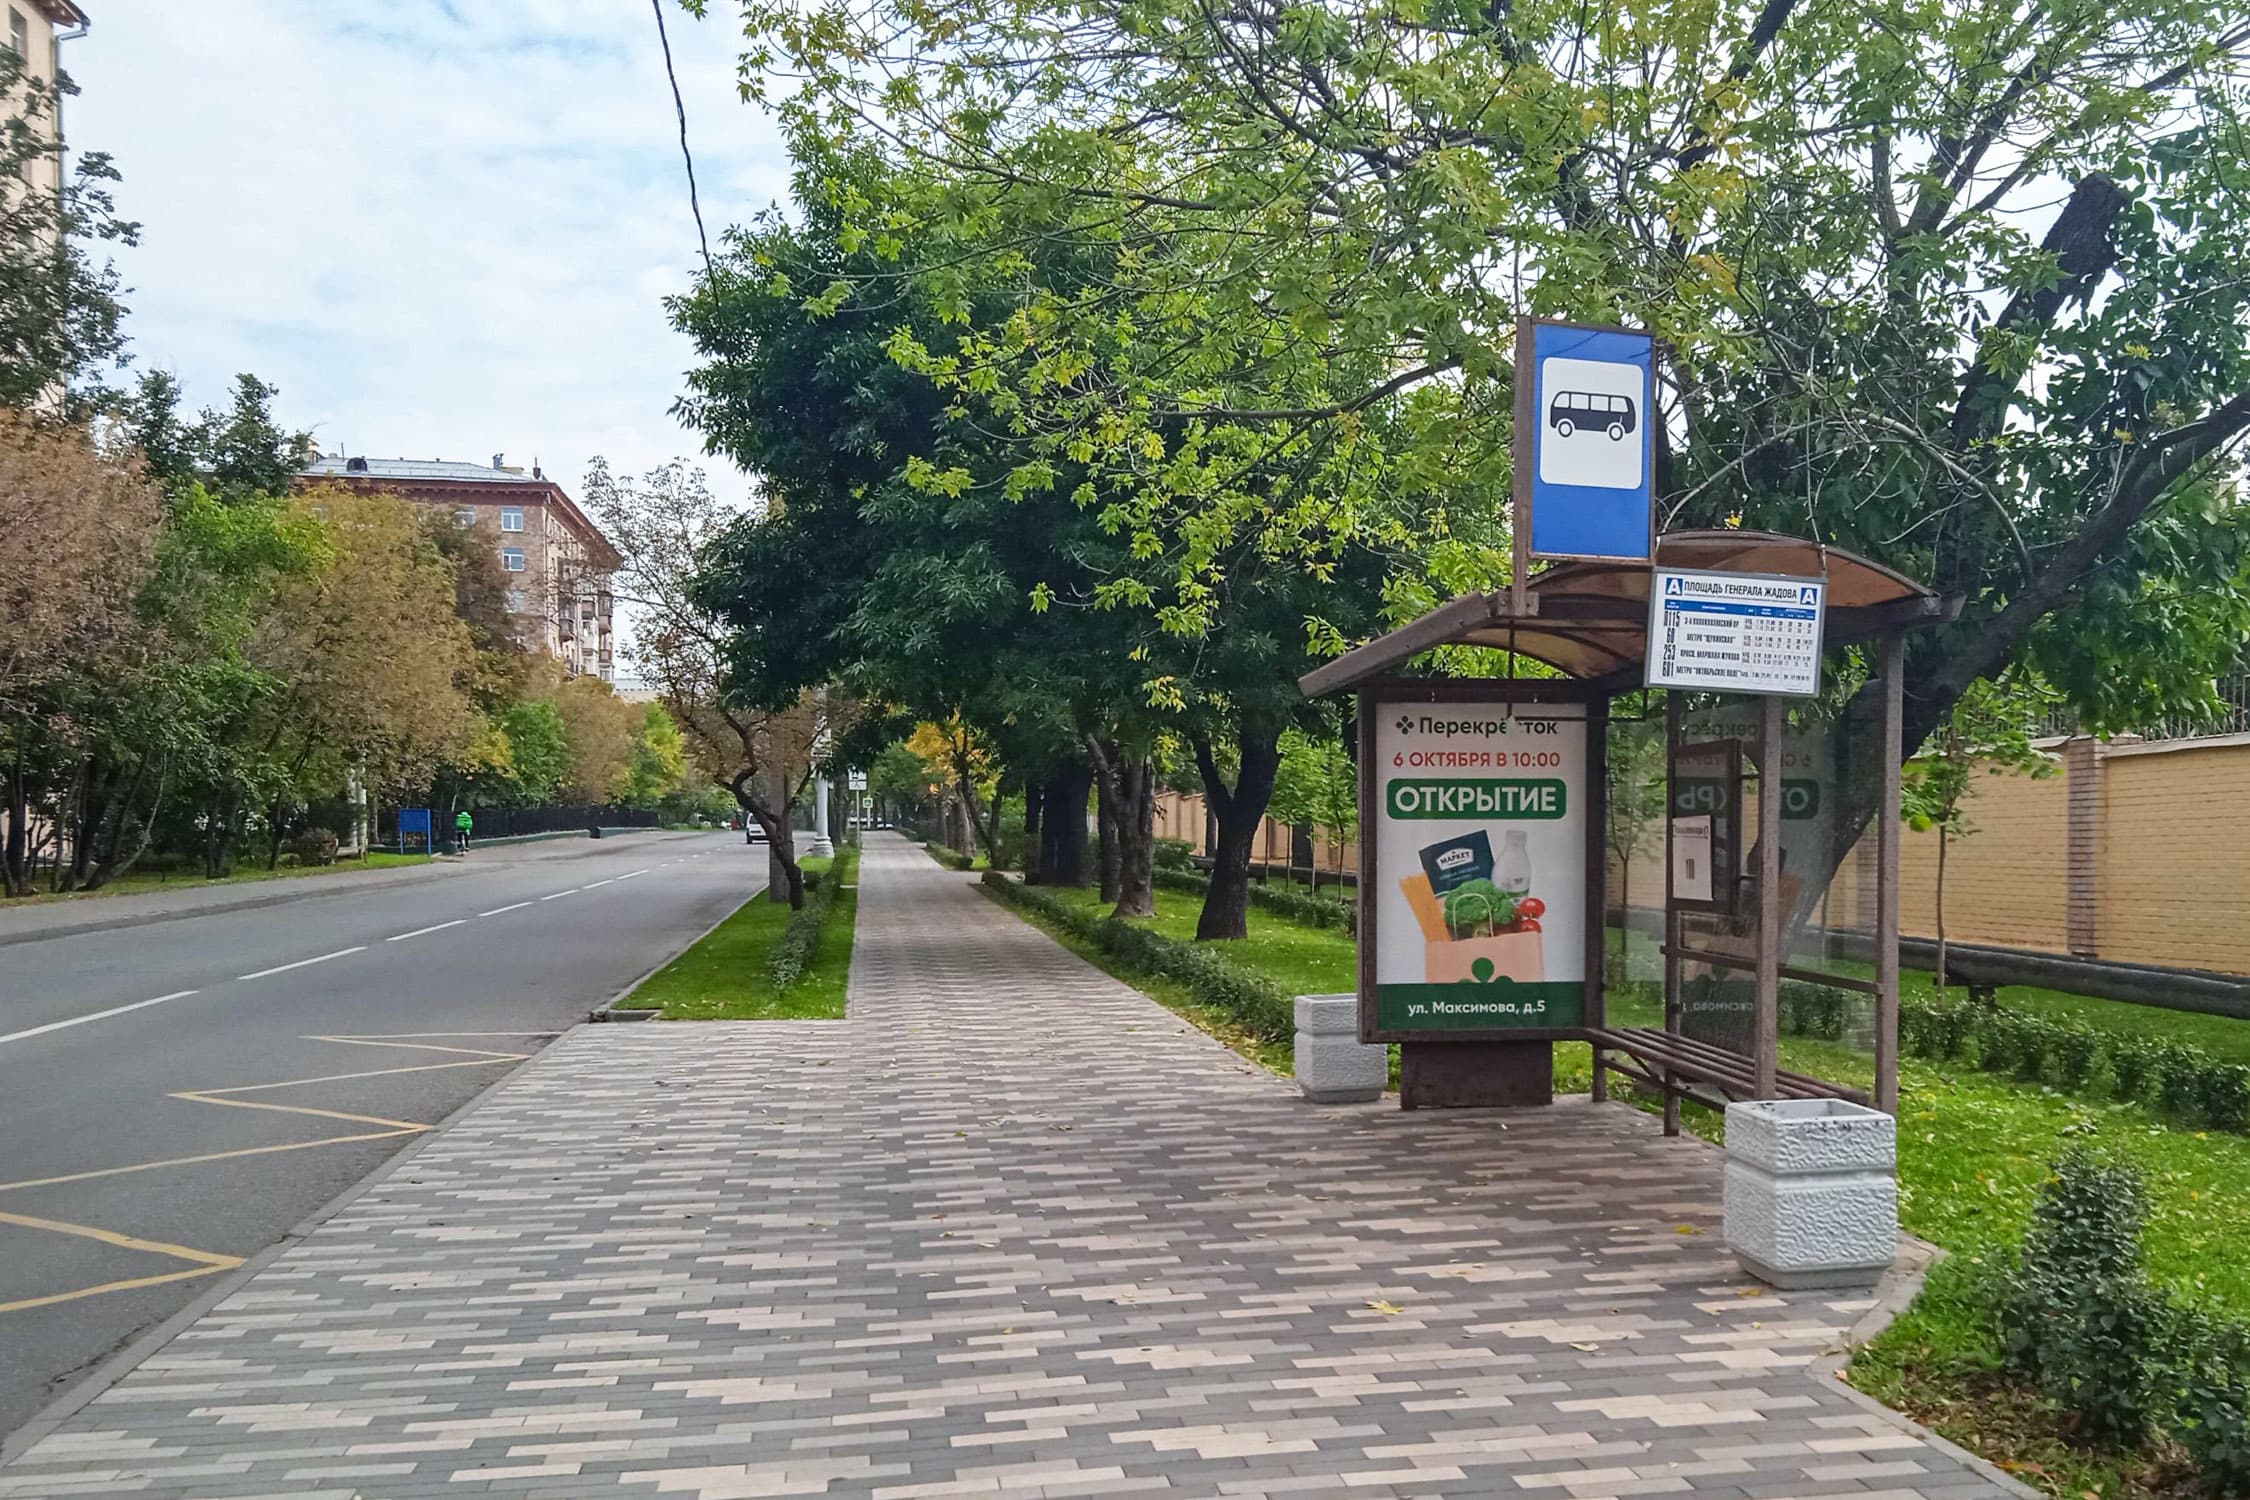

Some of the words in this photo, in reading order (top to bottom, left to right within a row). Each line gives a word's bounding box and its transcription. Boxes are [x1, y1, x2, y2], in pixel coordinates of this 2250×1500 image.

[1684, 581, 1723, 595] ПЛОЩАДЬ
[1724, 584, 1763, 597] ГЕНЕРАЛА
[1764, 586, 1797, 600] ЖАДОВА
[1663, 644, 1676, 660] 253
[1393, 752, 1404, 767] 6
[1409, 752, 1491, 767] ОКТЯБРЯ
[1496, 752, 1507, 767] В
[1512, 752, 1561, 767] 10:00
[1394, 786, 1557, 813] ОТКРЫТИЕ
[1408, 1003, 1427, 1016] ул.
[1432, 1001, 1520, 1016] Максимова,
[1523, 1000, 1546, 1015] д.5
